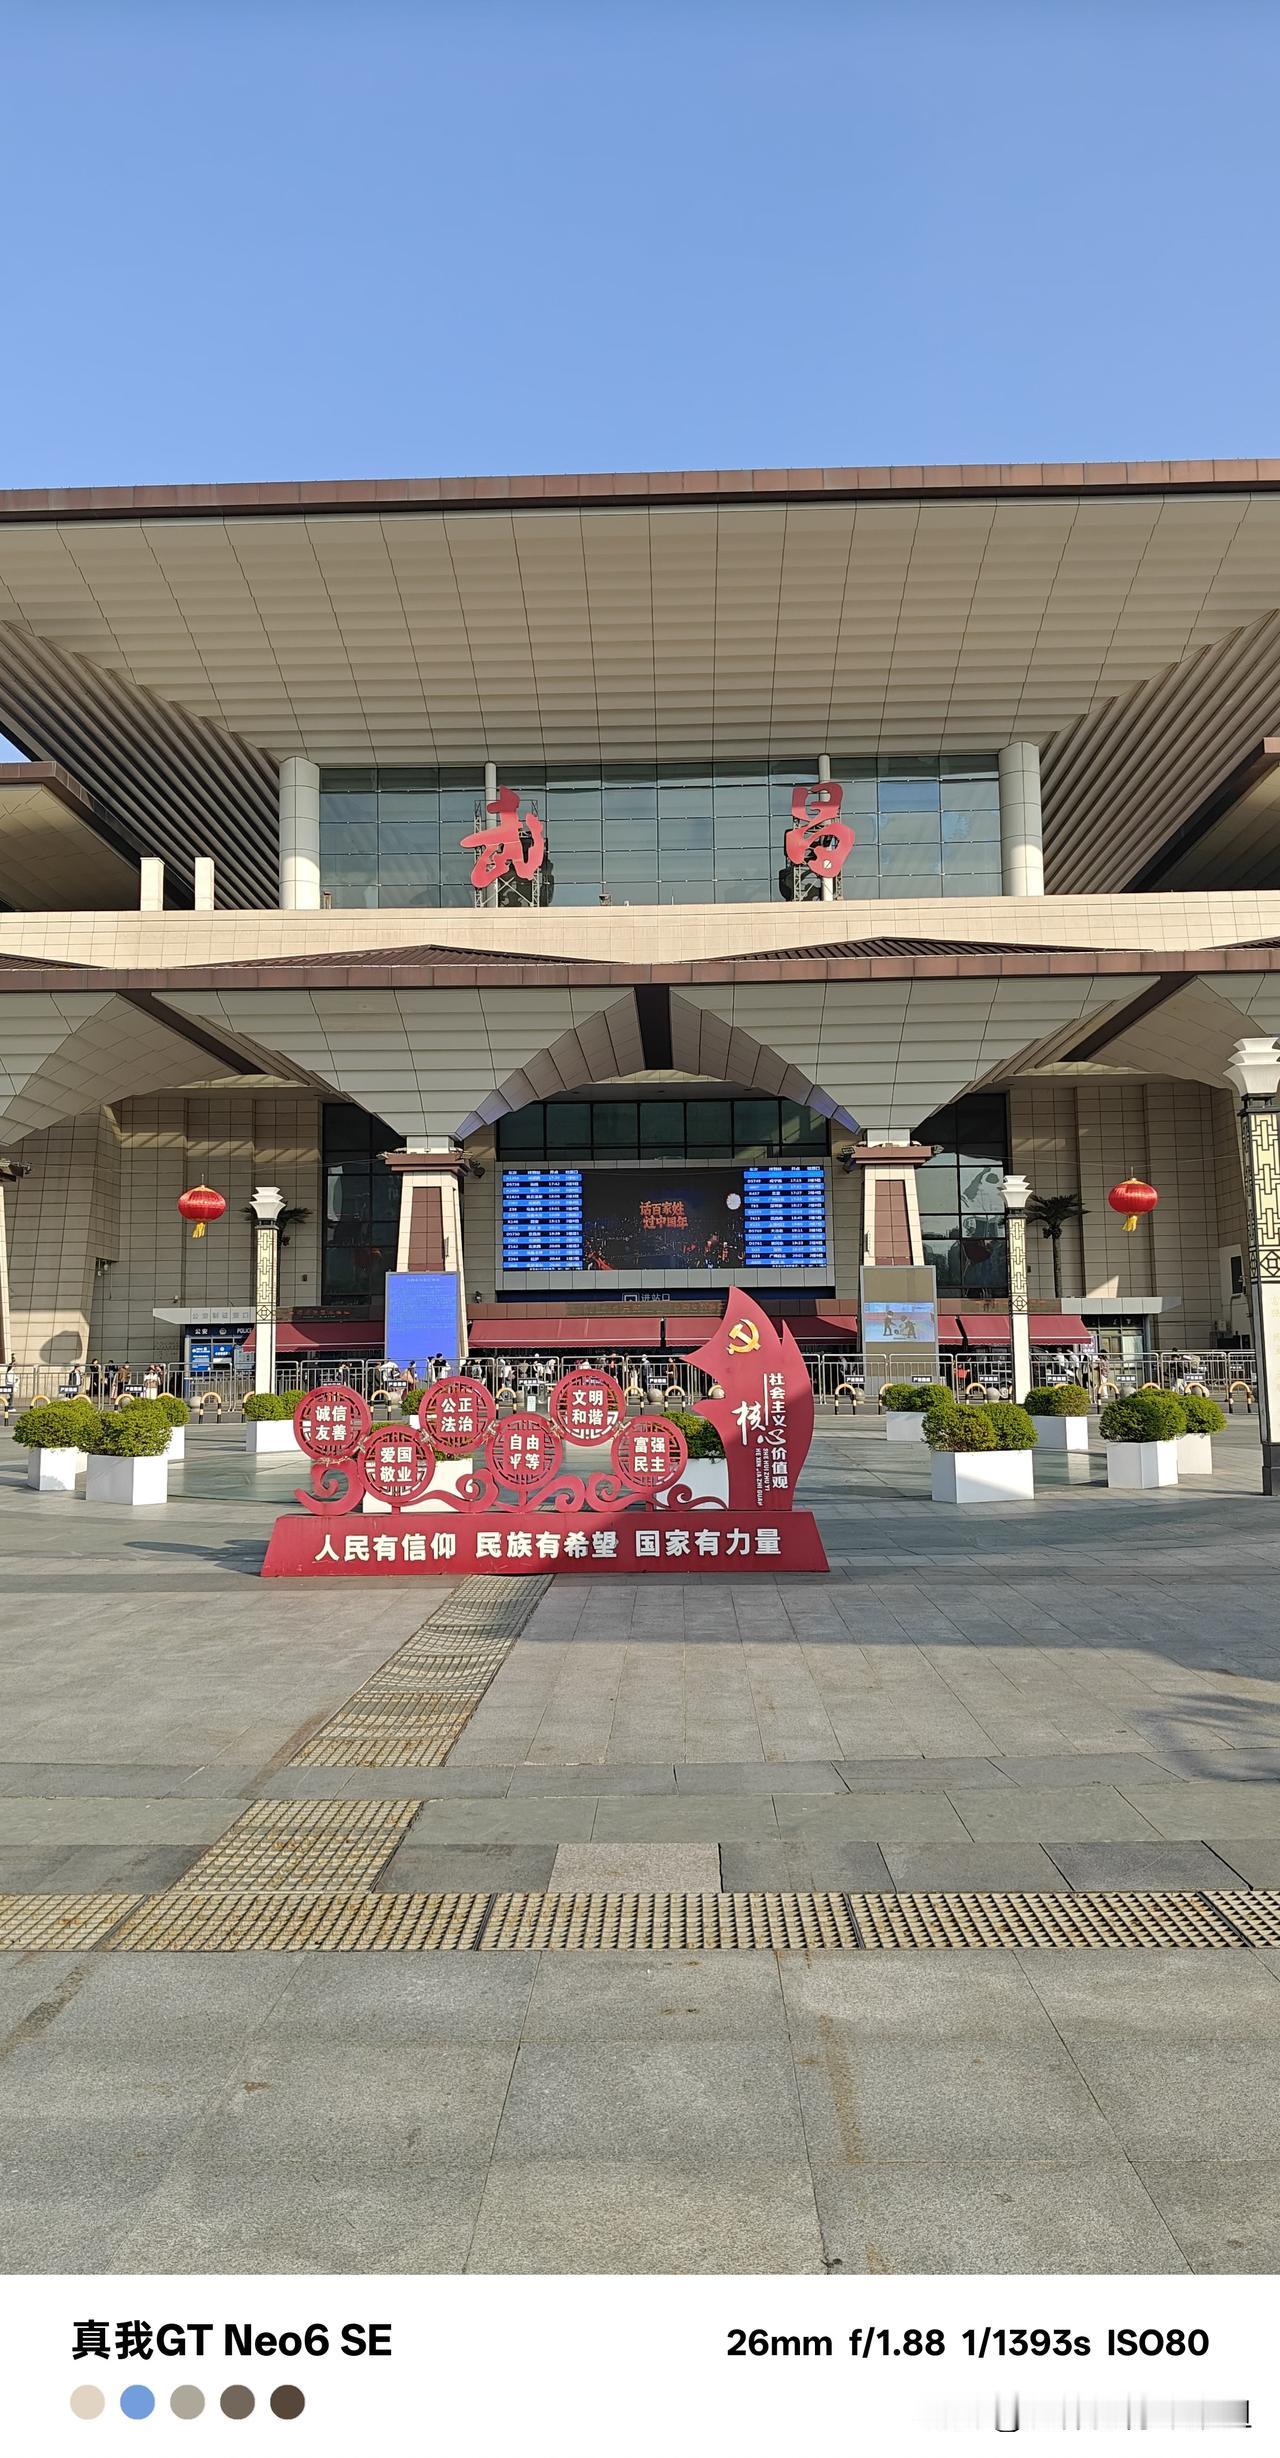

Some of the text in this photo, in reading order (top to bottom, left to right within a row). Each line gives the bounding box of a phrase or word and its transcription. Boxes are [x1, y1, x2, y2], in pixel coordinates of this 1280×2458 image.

[441, 1397, 473, 1414] 公正
[572, 1389, 604, 1406] 文明
[768, 1372, 787, 1427] 社会主义
[315, 1404, 348, 1422] 诚信
[571, 1408, 604, 1426] 和谐
[315, 1424, 347, 1441] 友善
[441, 1416, 474, 1433] 法治
[510, 1433, 540, 1451] 自由
[633, 1436, 666, 1454] 富强
[380, 1446, 413, 1464] 爱国
[633, 1455, 666, 1473] 民主
[379, 1466, 413, 1483] 敬业
[771, 1447, 788, 1489] 价值观
[314, 1528, 782, 1562] 人民有信仰 民族有希望 国家有力量
